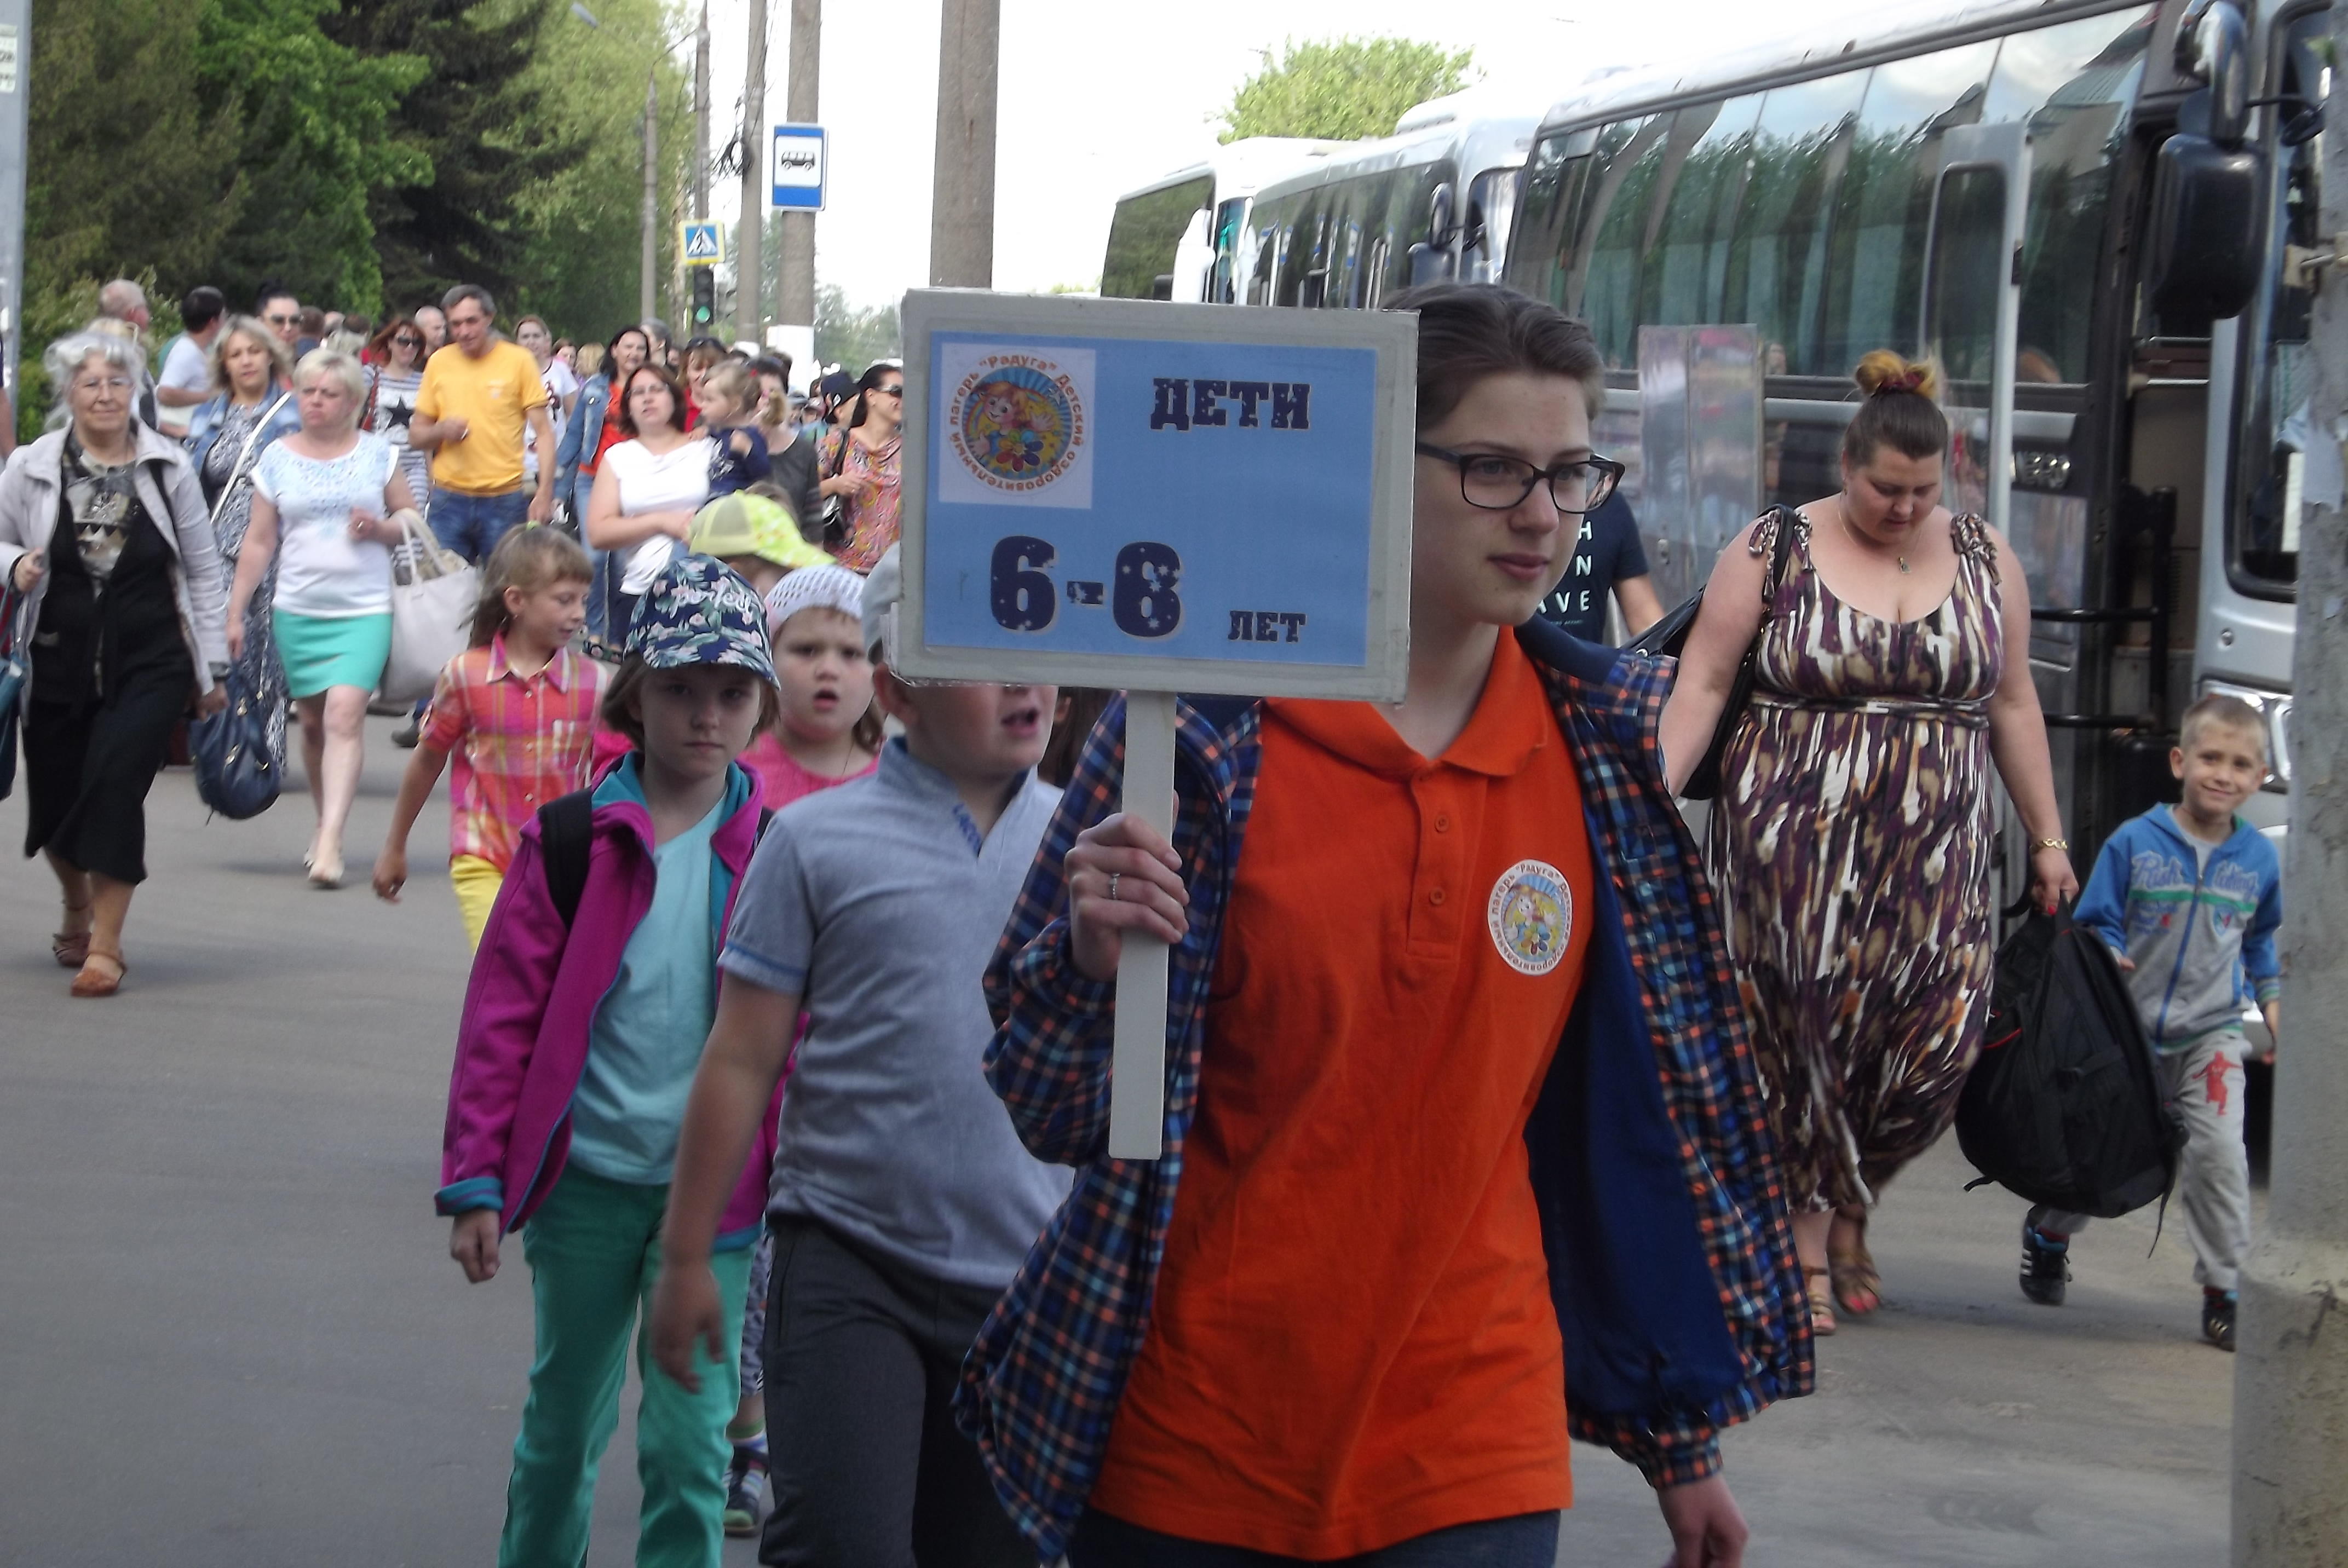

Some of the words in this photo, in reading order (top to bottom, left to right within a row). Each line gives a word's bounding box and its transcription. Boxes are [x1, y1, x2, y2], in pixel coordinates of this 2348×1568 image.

[950, 372, 979, 425] лагерь
[1054, 373, 1084, 446] Детский
[1150, 378, 1310, 431] ДЕТИ
[990, 535, 1181, 637] 6-8
[1227, 609, 1307, 642] ЛЕТ
